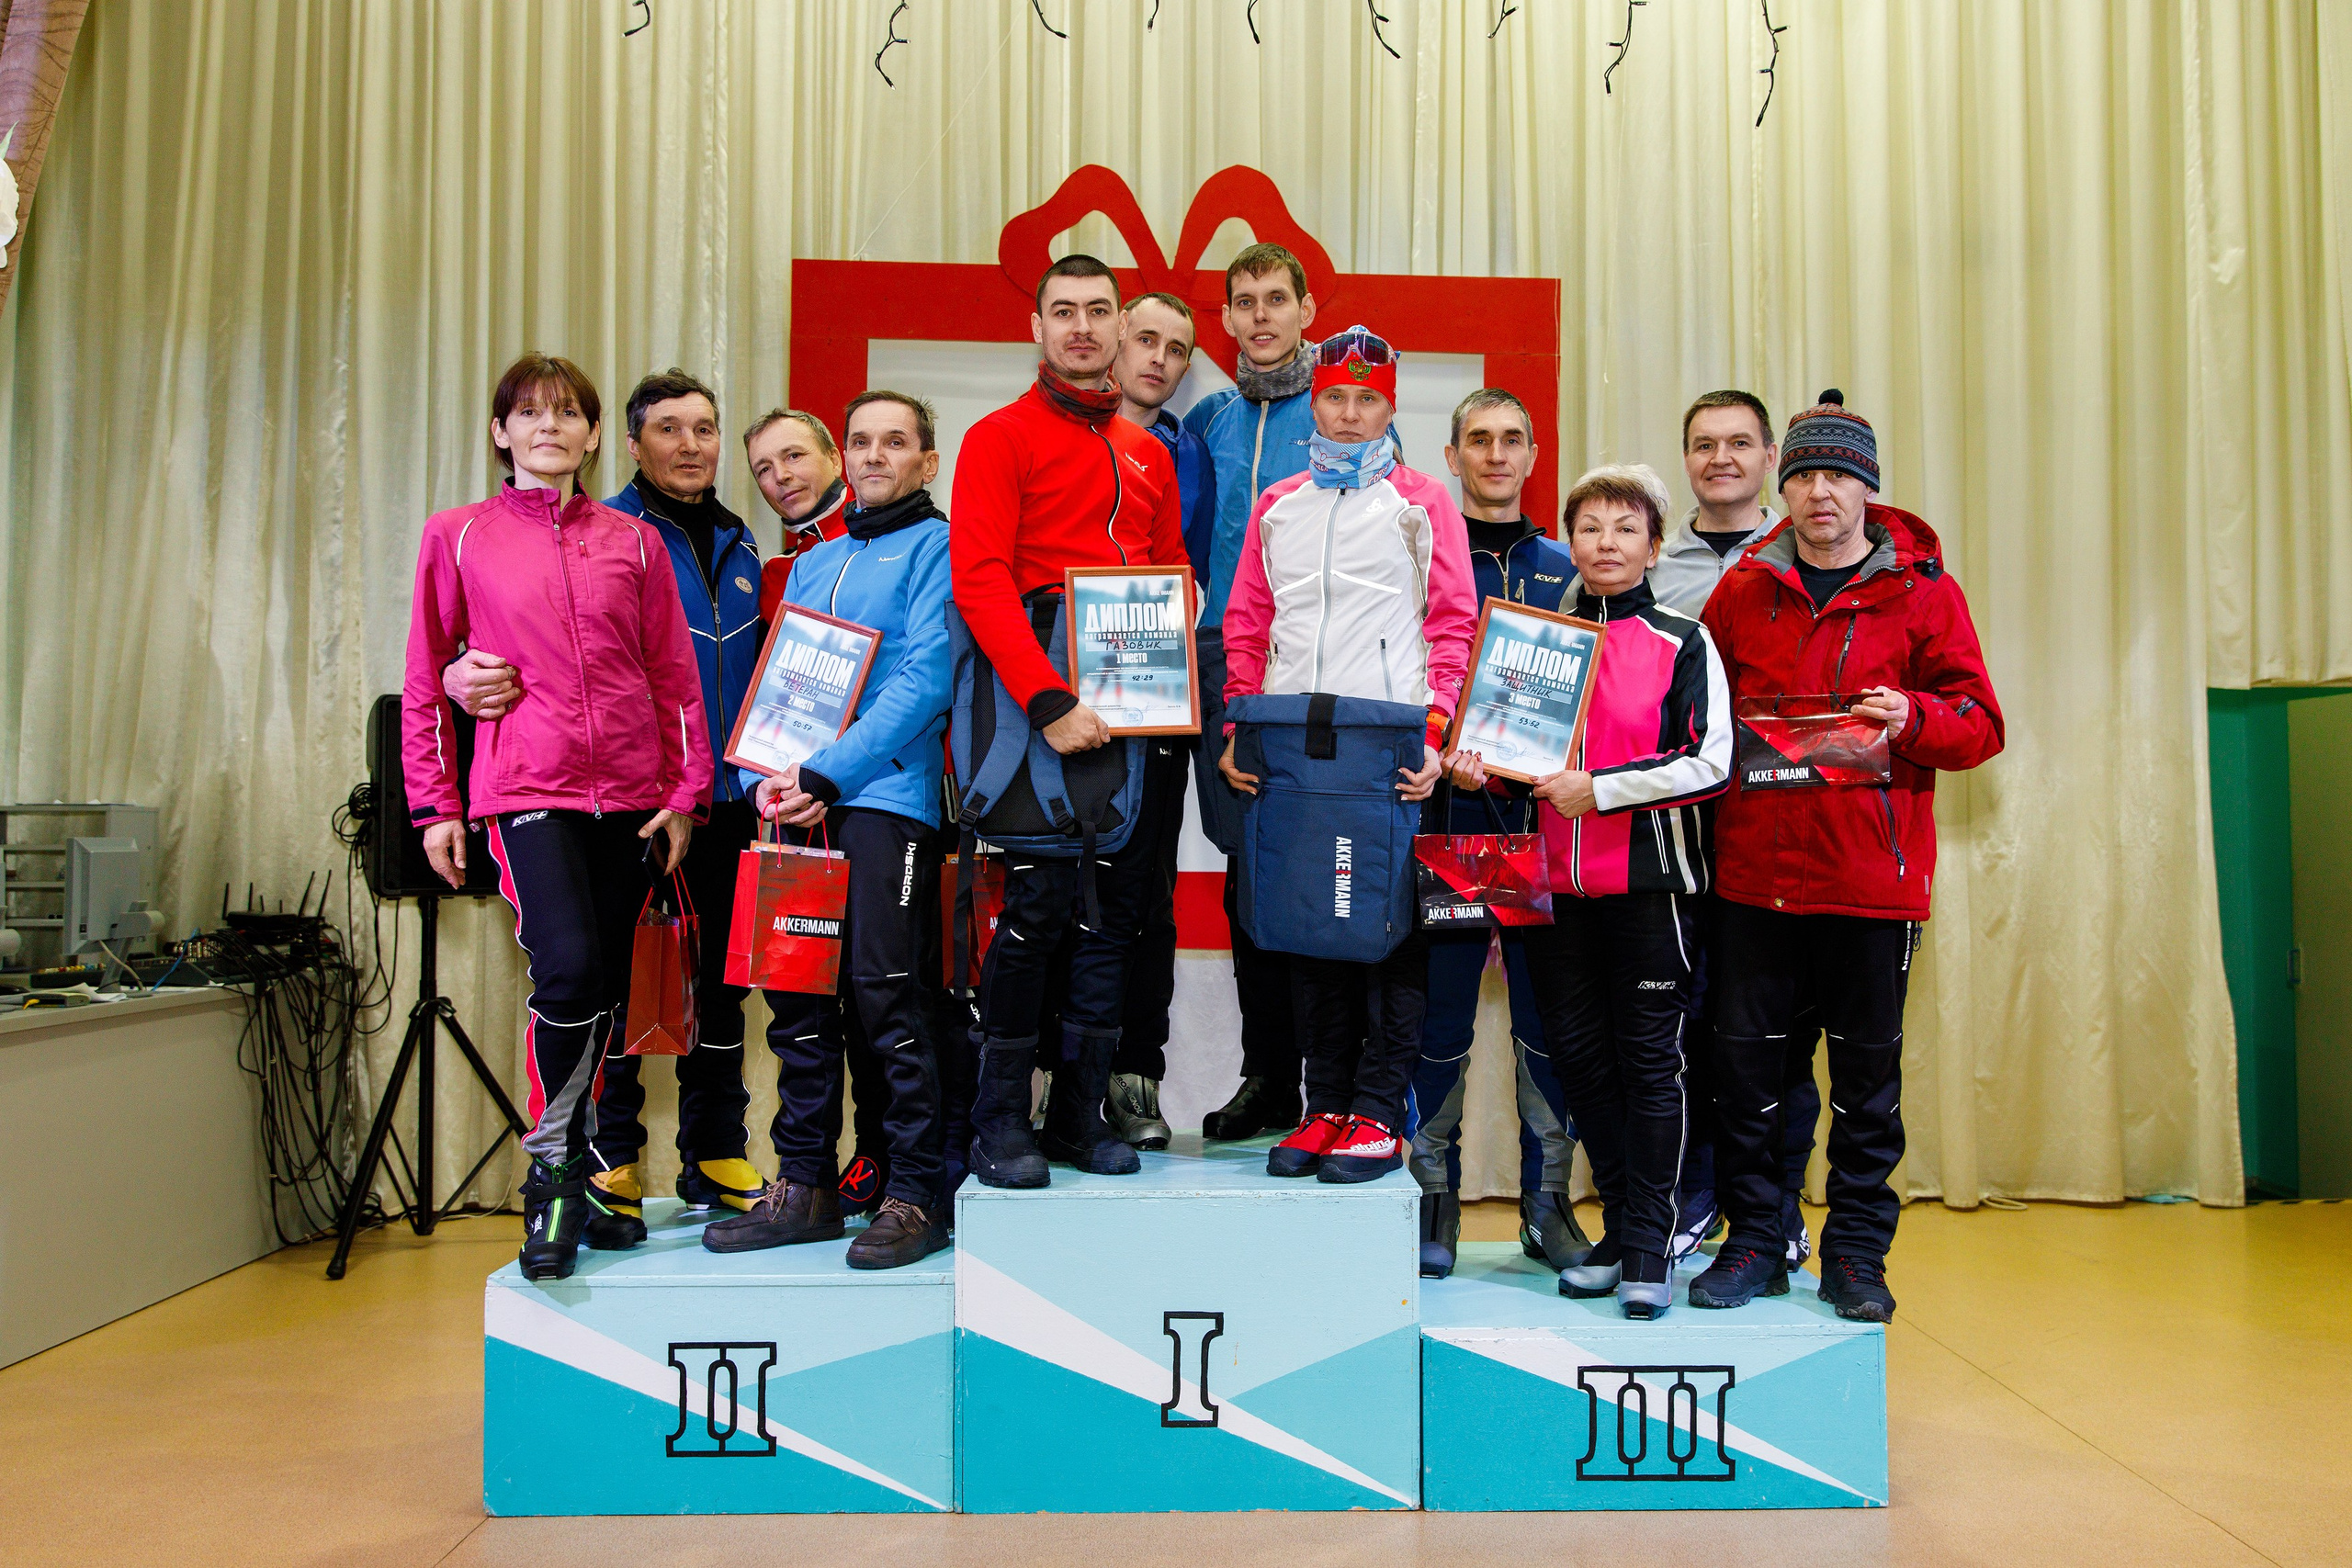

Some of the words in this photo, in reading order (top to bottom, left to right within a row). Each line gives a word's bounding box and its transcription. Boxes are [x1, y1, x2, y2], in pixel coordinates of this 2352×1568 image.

[1084, 603, 1177, 633] ДИПЛОМ
[1105, 641, 1163, 650] ГАЗОВИК
[775, 638, 856, 690] ДИПЛОМ
[1116, 653, 1121, 664] 1
[1487, 636, 1582, 686] ДИПЛОМ
[783, 680, 820, 700] ВЕТЕРАН
[1500, 678, 1553, 699] ЗАЩИТНИК
[1508, 693, 1515, 703] 3
[787, 694, 795, 705] 2
[1747, 766, 1809, 784] AKKERMANN
[899, 841, 917, 907] NORDSKI
[1335, 836, 1352, 919] AKKERMANN
[1428, 906, 1484, 920] AKKERMANN
[773, 916, 840, 936] AKKERMANN
[1350, 1136, 1391, 1152] alpina
[1160, 1311, 1224, 1427] I
[665, 1341, 777, 1458] II
[1576, 1365, 1736, 1482] III
